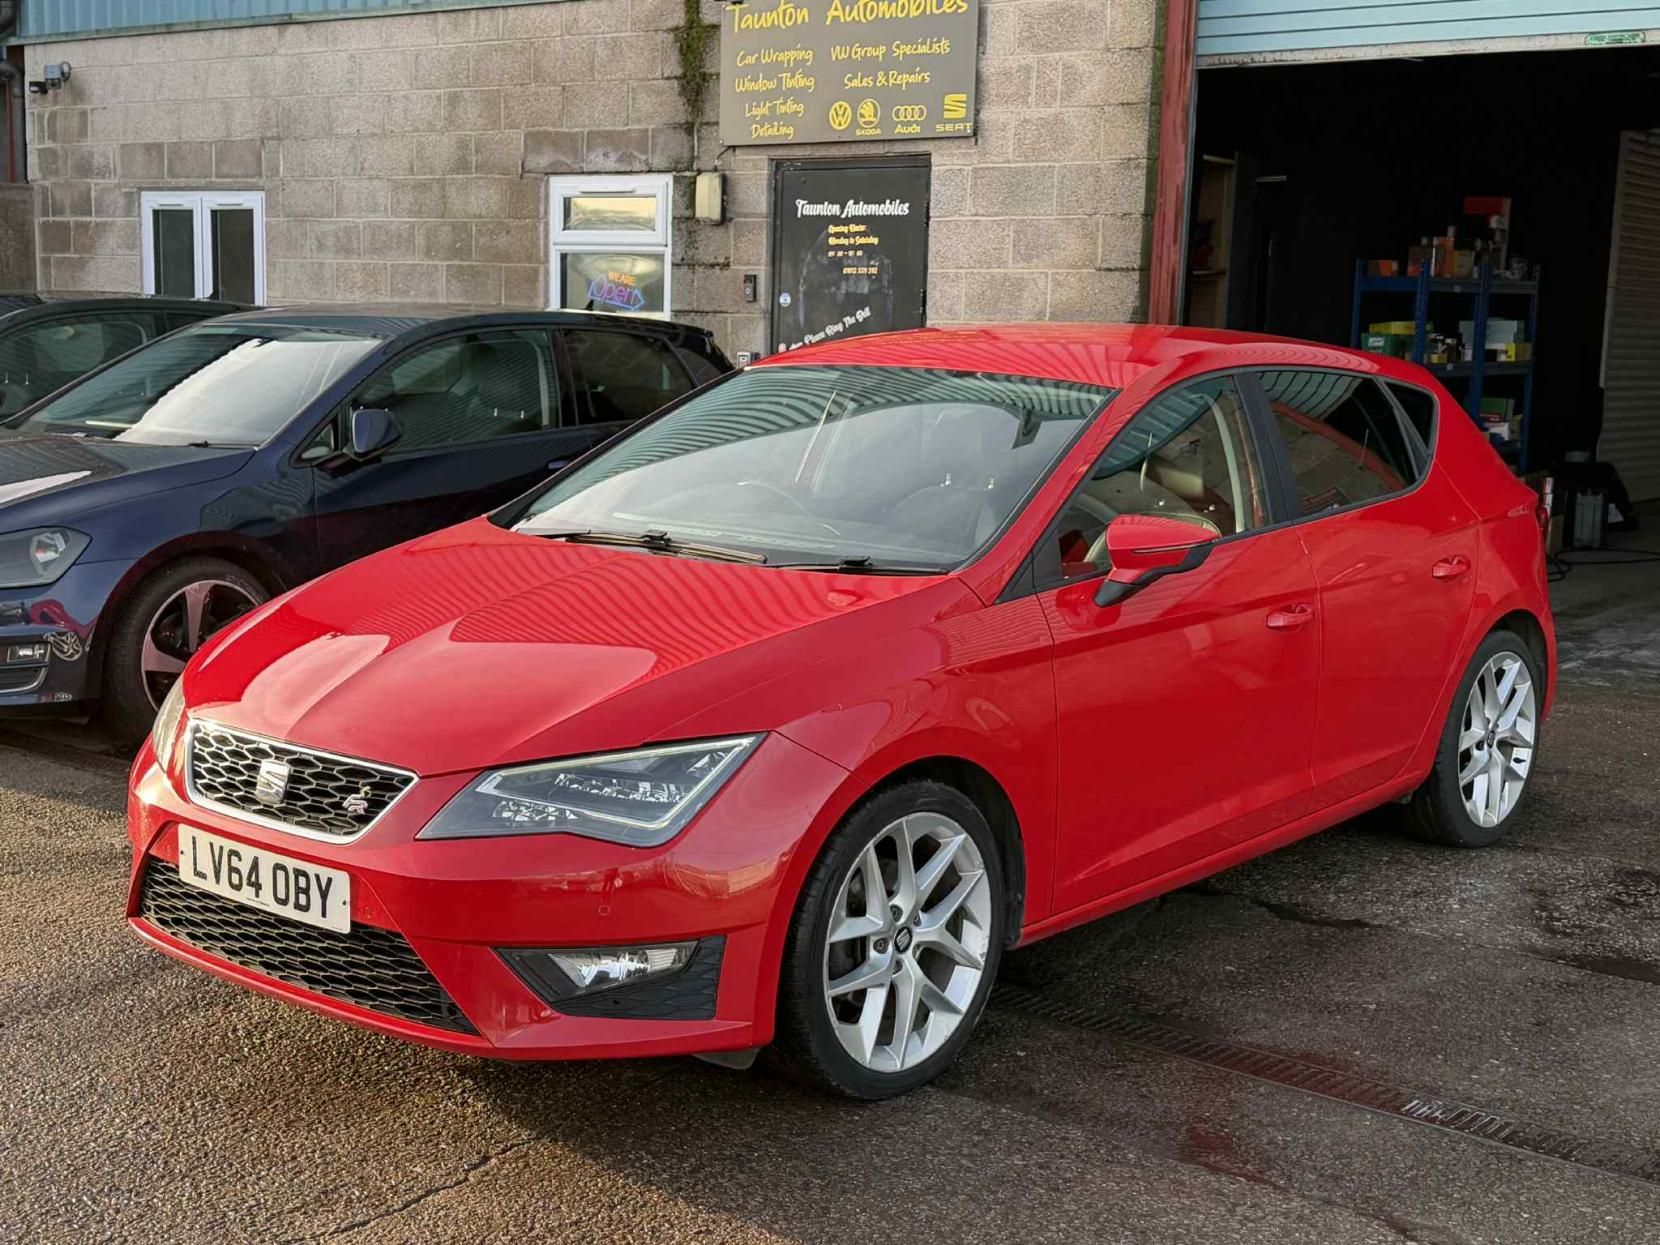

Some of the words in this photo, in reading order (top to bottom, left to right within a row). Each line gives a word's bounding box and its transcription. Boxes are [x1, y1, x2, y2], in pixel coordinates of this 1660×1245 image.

[725, 0, 810, 33] Taunton
[826, 0, 968, 25] Automobiles
[736, 50, 759, 67] Car
[760, 43, 814, 67] Wrapping
[830, 46, 850, 61] VW
[851, 43, 887, 61] Group
[892, 37, 951, 61] Specialists
[735, 73, 777, 93] Window
[778, 69, 816, 93] Tinting
[844, 72, 874, 90] Sales
[876, 71, 888, 86] &
[889, 67, 931, 90] Repairs
[745, 101, 771, 120] Light
[773, 97, 805, 117] Tinting
[751, 121, 795, 140] Detailing
[895, 124, 921, 134] Audi
[935, 122, 973, 133] SEAT
[795, 199, 841, 218] Taunton
[840, 199, 910, 218] Automobiles
[593, 274, 635, 303] Open
[192, 835, 263, 898] LV64
[272, 862, 334, 919] OBY
